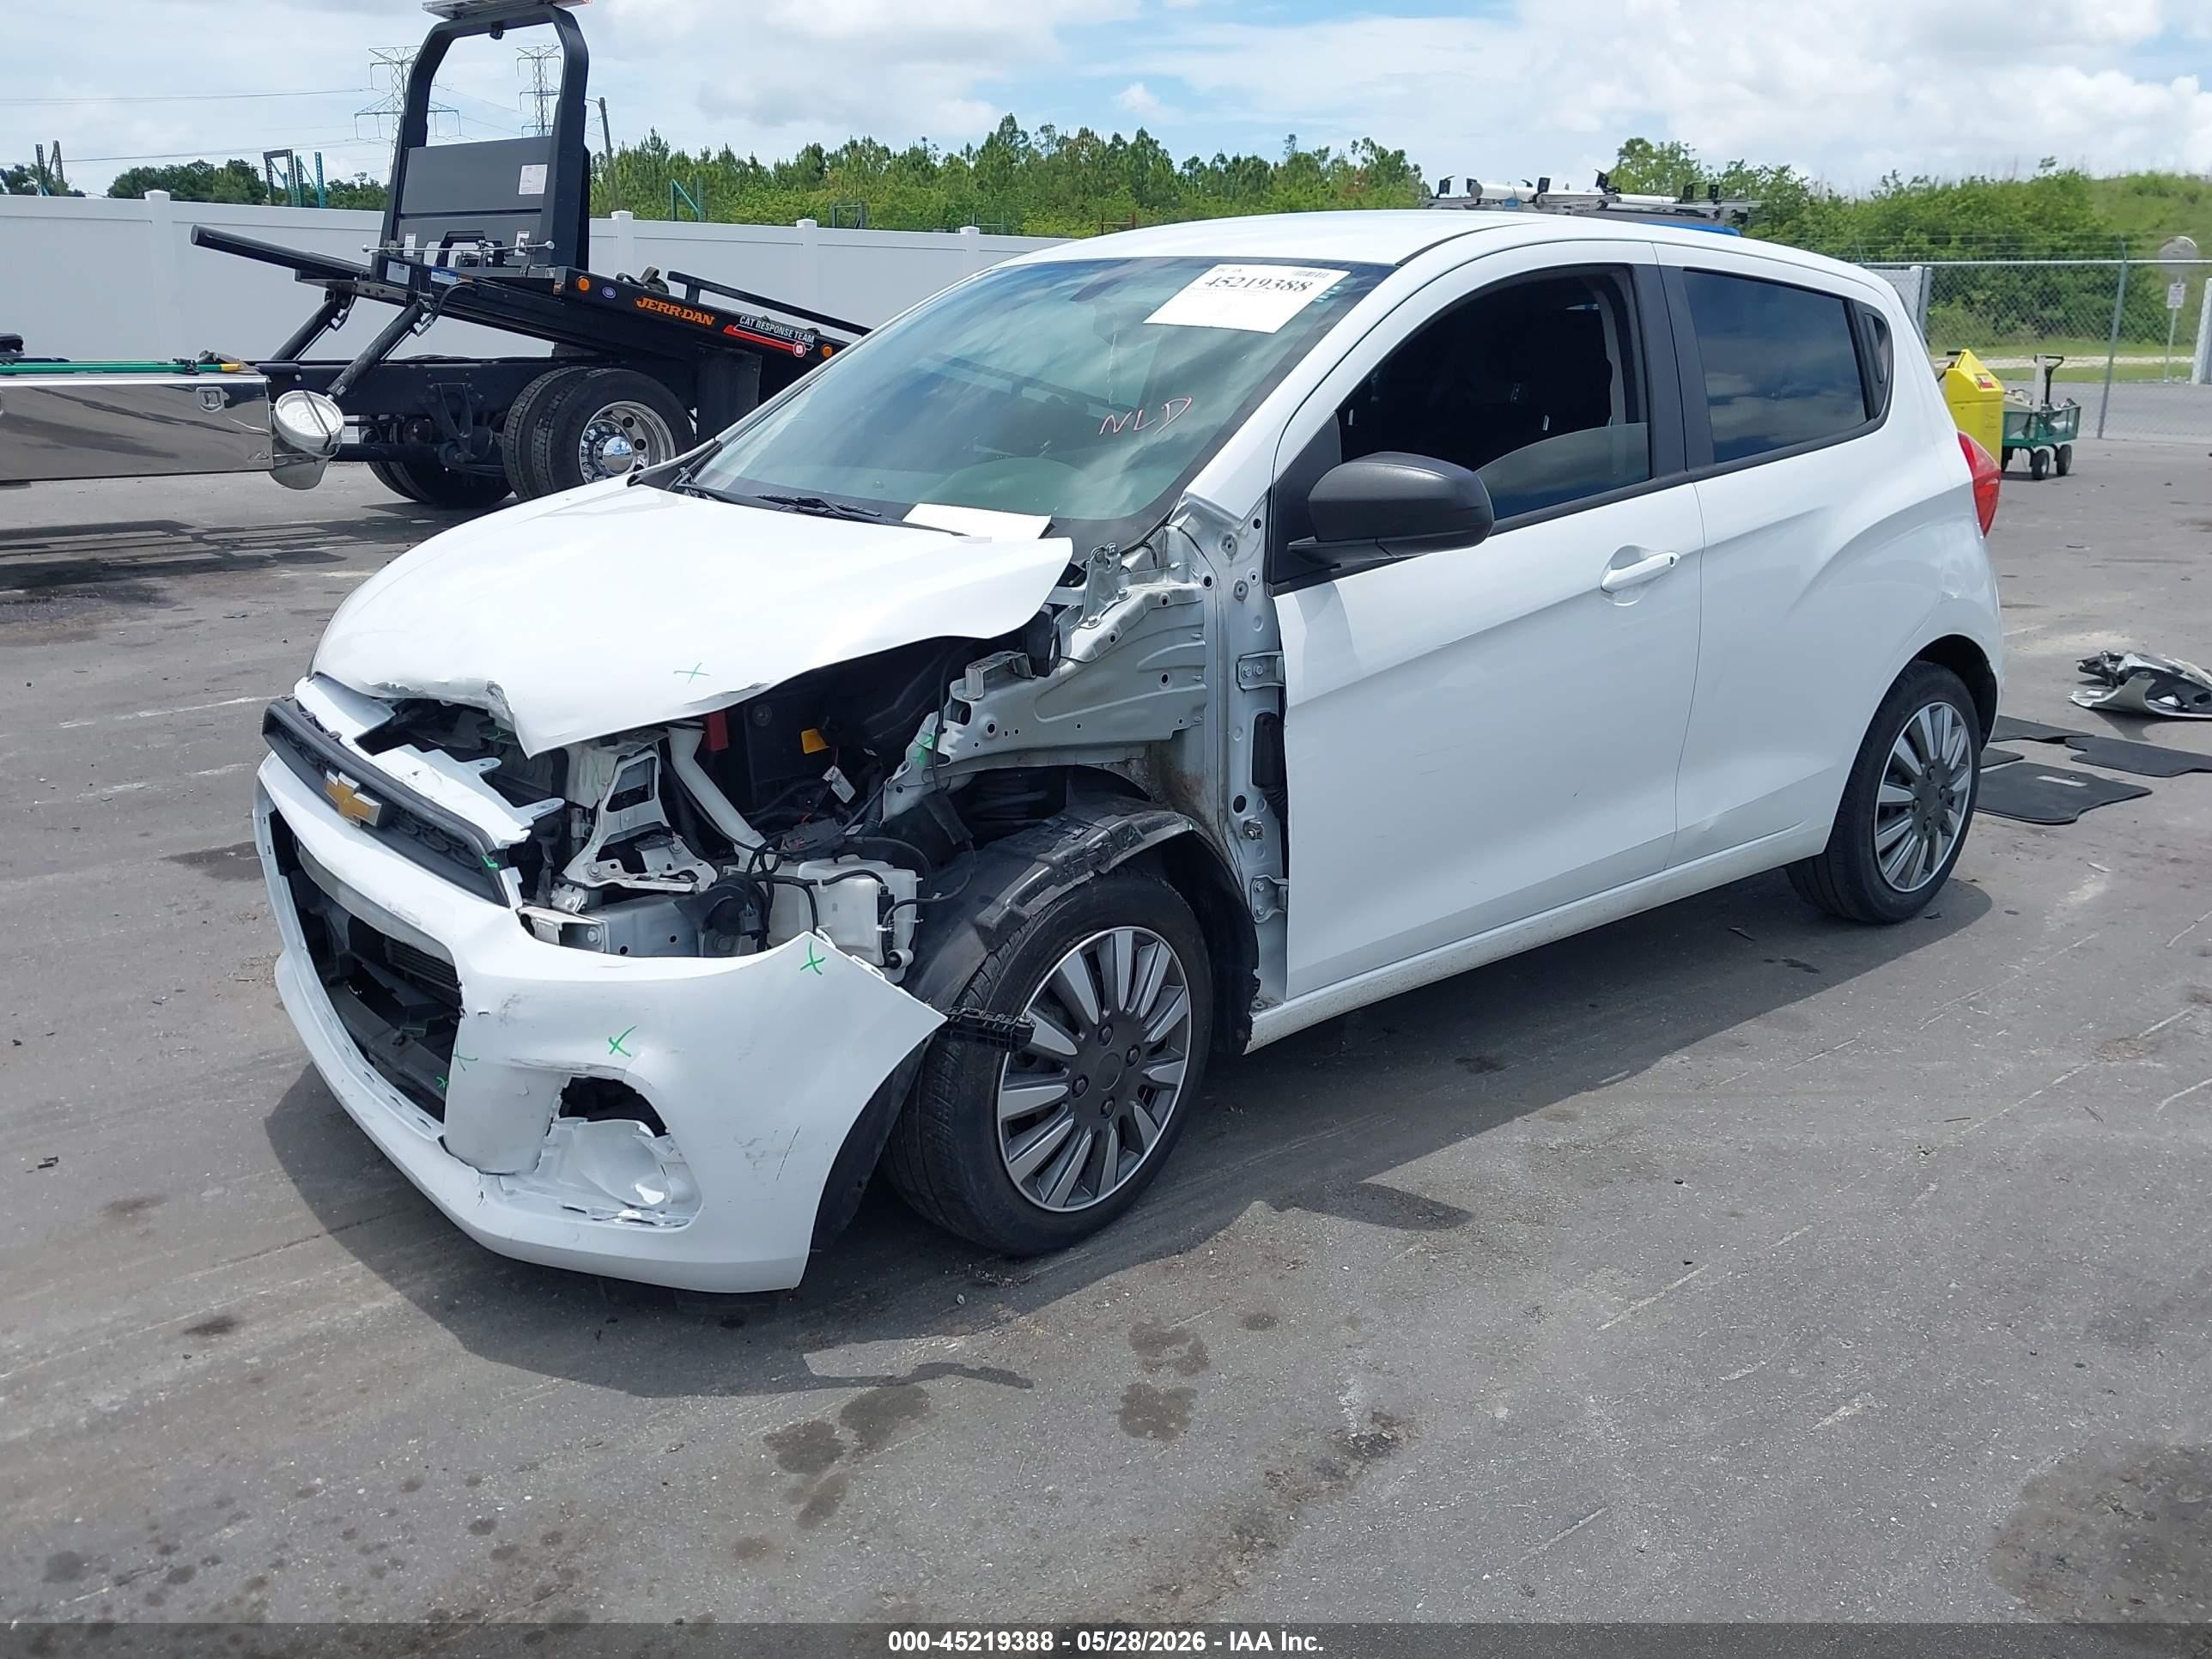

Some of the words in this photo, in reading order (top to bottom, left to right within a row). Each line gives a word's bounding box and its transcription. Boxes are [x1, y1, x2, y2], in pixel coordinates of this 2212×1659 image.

[1204, 276, 1313, 293] 45219388
[738, 315, 756, 326] CAT
[756, 319, 793, 337] RESPONSE
[794, 331, 815, 344] TEAM
[1098, 397, 1193, 435] NLD
